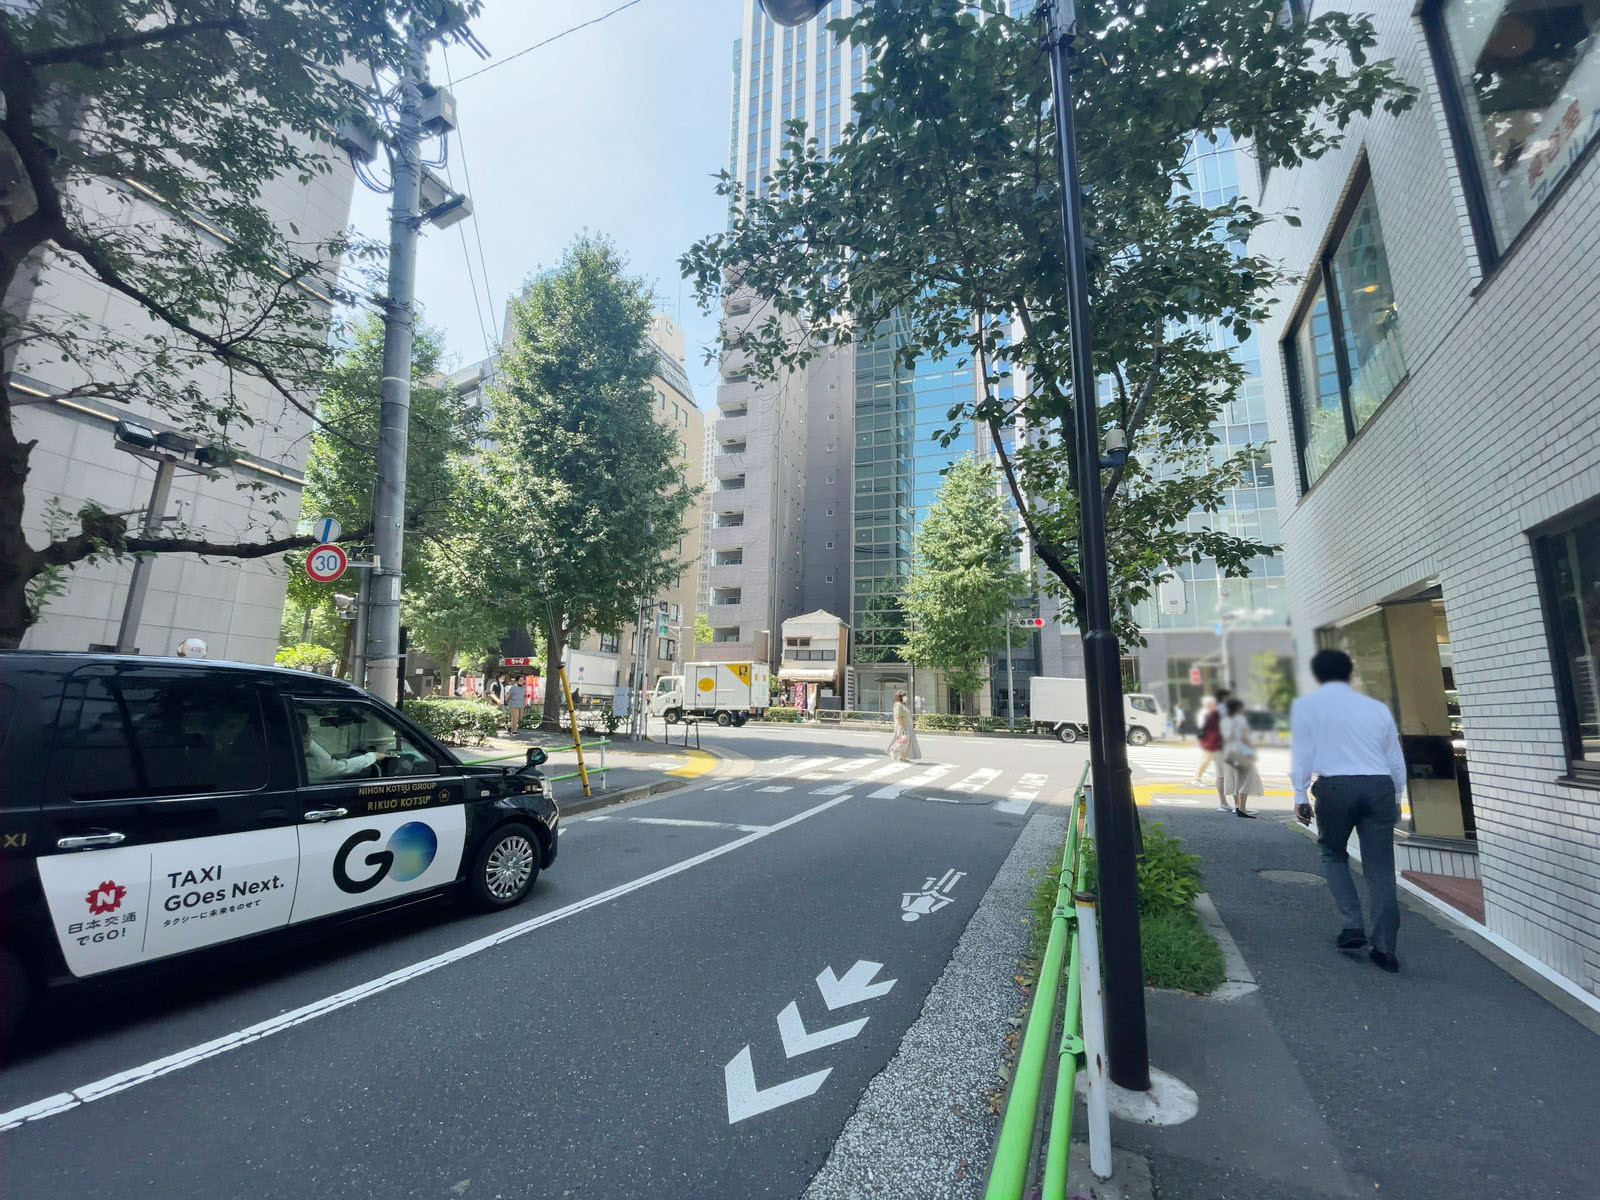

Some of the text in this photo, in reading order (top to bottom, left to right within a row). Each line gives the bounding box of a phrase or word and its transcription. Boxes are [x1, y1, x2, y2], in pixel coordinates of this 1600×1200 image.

[315, 555, 337, 571] 30
[358, 782, 437, 796] NIHON KOTSU GROUP
[367, 796, 428, 811] RIKUO KOTSU
[333, 821, 438, 894] GO
[167, 864, 222, 889] TAXI
[96, 889, 116, 907] N
[164, 875, 285, 912] GOes Next.
[68, 911, 136, 935] 日本交通
[163, 899, 262, 927] タクシーに未来をのせて
[77, 927, 126, 946] でGO!
